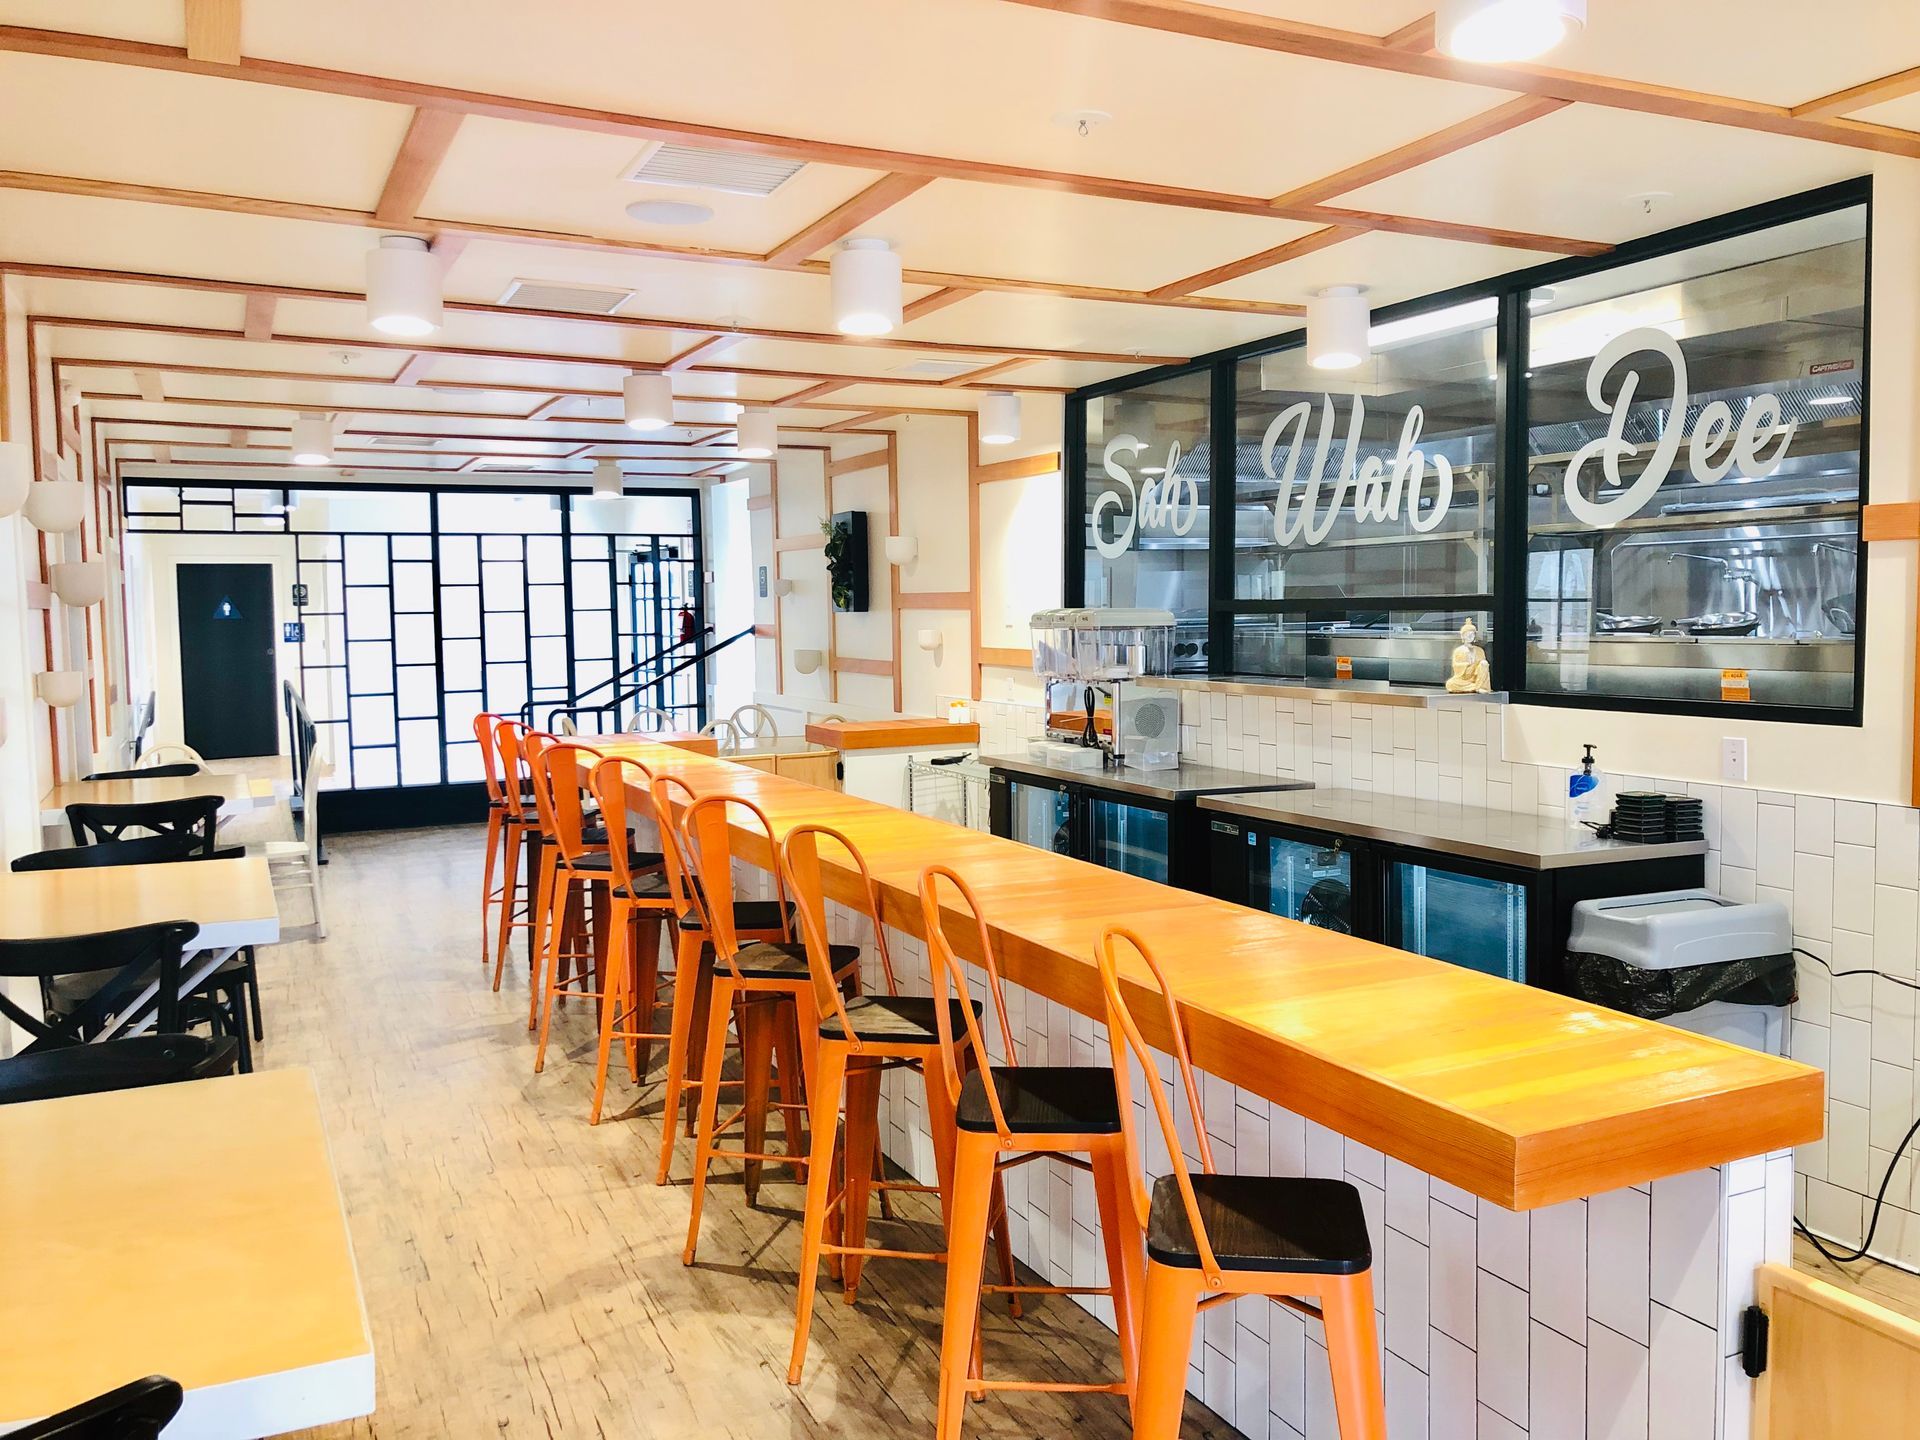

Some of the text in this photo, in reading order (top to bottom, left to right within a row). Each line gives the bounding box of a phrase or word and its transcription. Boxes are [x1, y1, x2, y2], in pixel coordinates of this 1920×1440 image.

[1092, 327, 1798, 559] Sah Wah Dee
